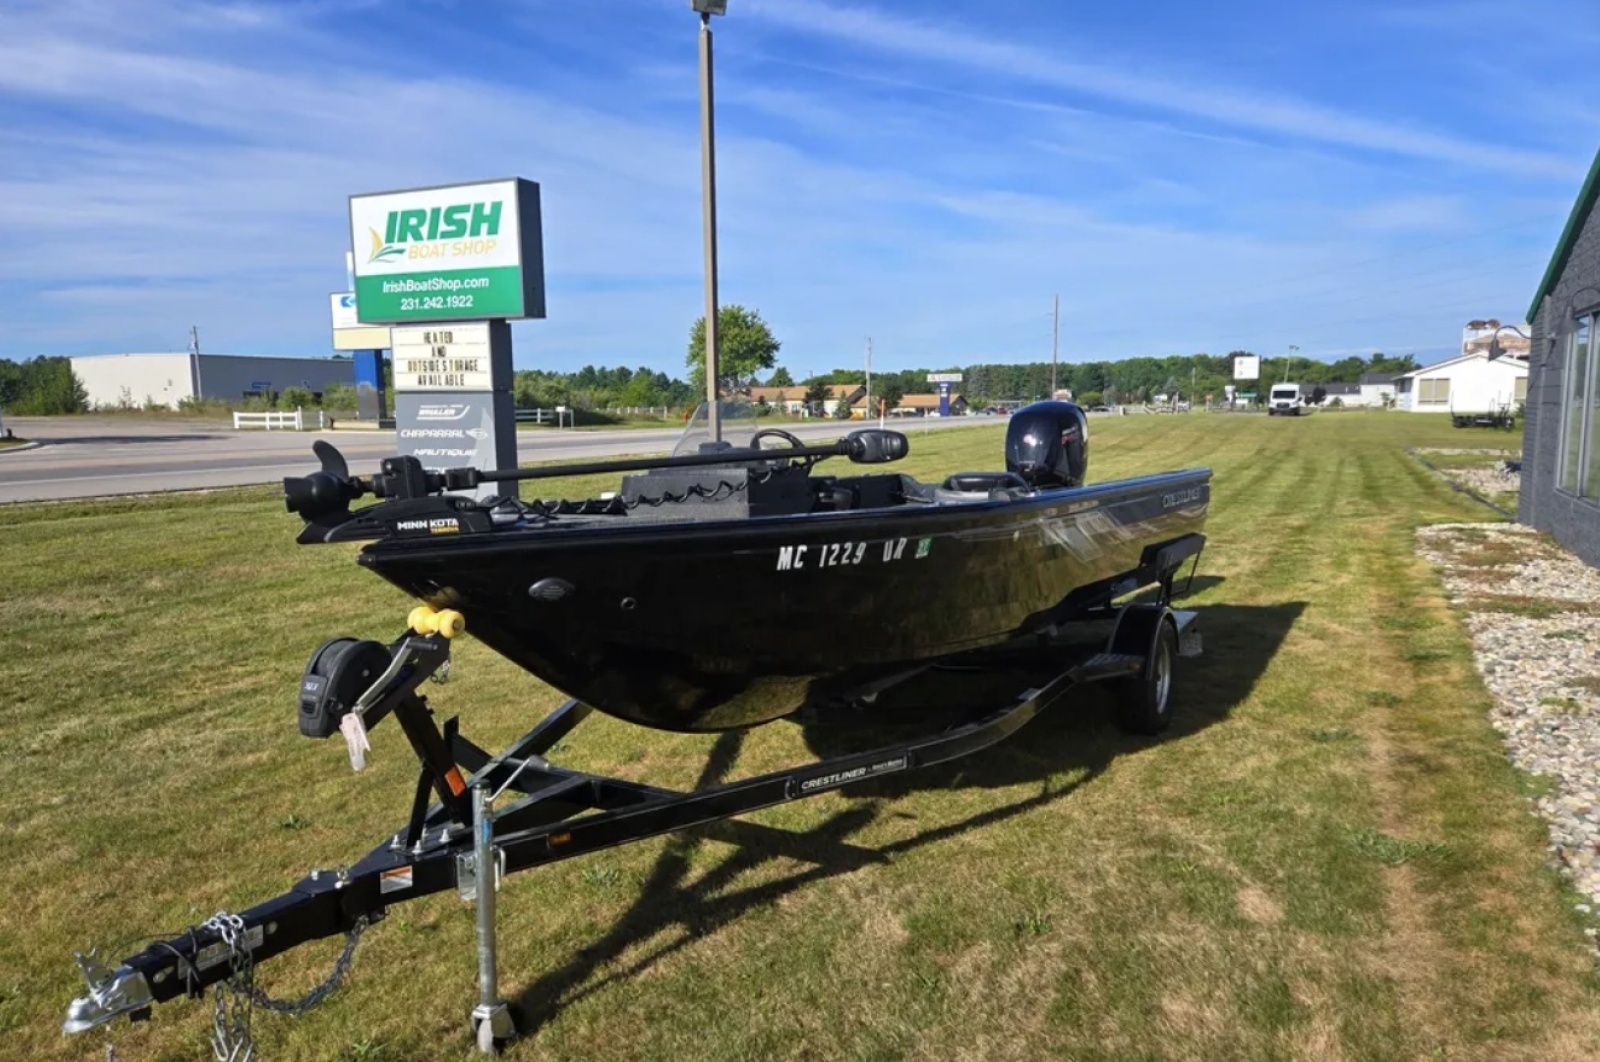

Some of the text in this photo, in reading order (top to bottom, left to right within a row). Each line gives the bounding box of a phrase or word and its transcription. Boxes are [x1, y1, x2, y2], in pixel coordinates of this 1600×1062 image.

[385, 201, 502, 244] IRISH
[408, 239, 496, 259] BOAT SHOP
[383, 277, 489, 293] IrishBoatShop.com
[400, 295, 473, 310] 231.242.1922
[424, 332, 453, 344] HEATED
[432, 346, 446, 358] AND
[407, 359, 478, 373] OUTSIDE STORAGE
[417, 374, 464, 386] AVAILABLE
[400, 429, 465, 438] CHAPARRAL
[397, 520, 428, 530] MINN
[429, 518, 459, 527] KOTA
[776, 545, 807, 571] MC
[819, 542, 867, 568] 1229
[801, 767, 867, 790] CRESTLINER
